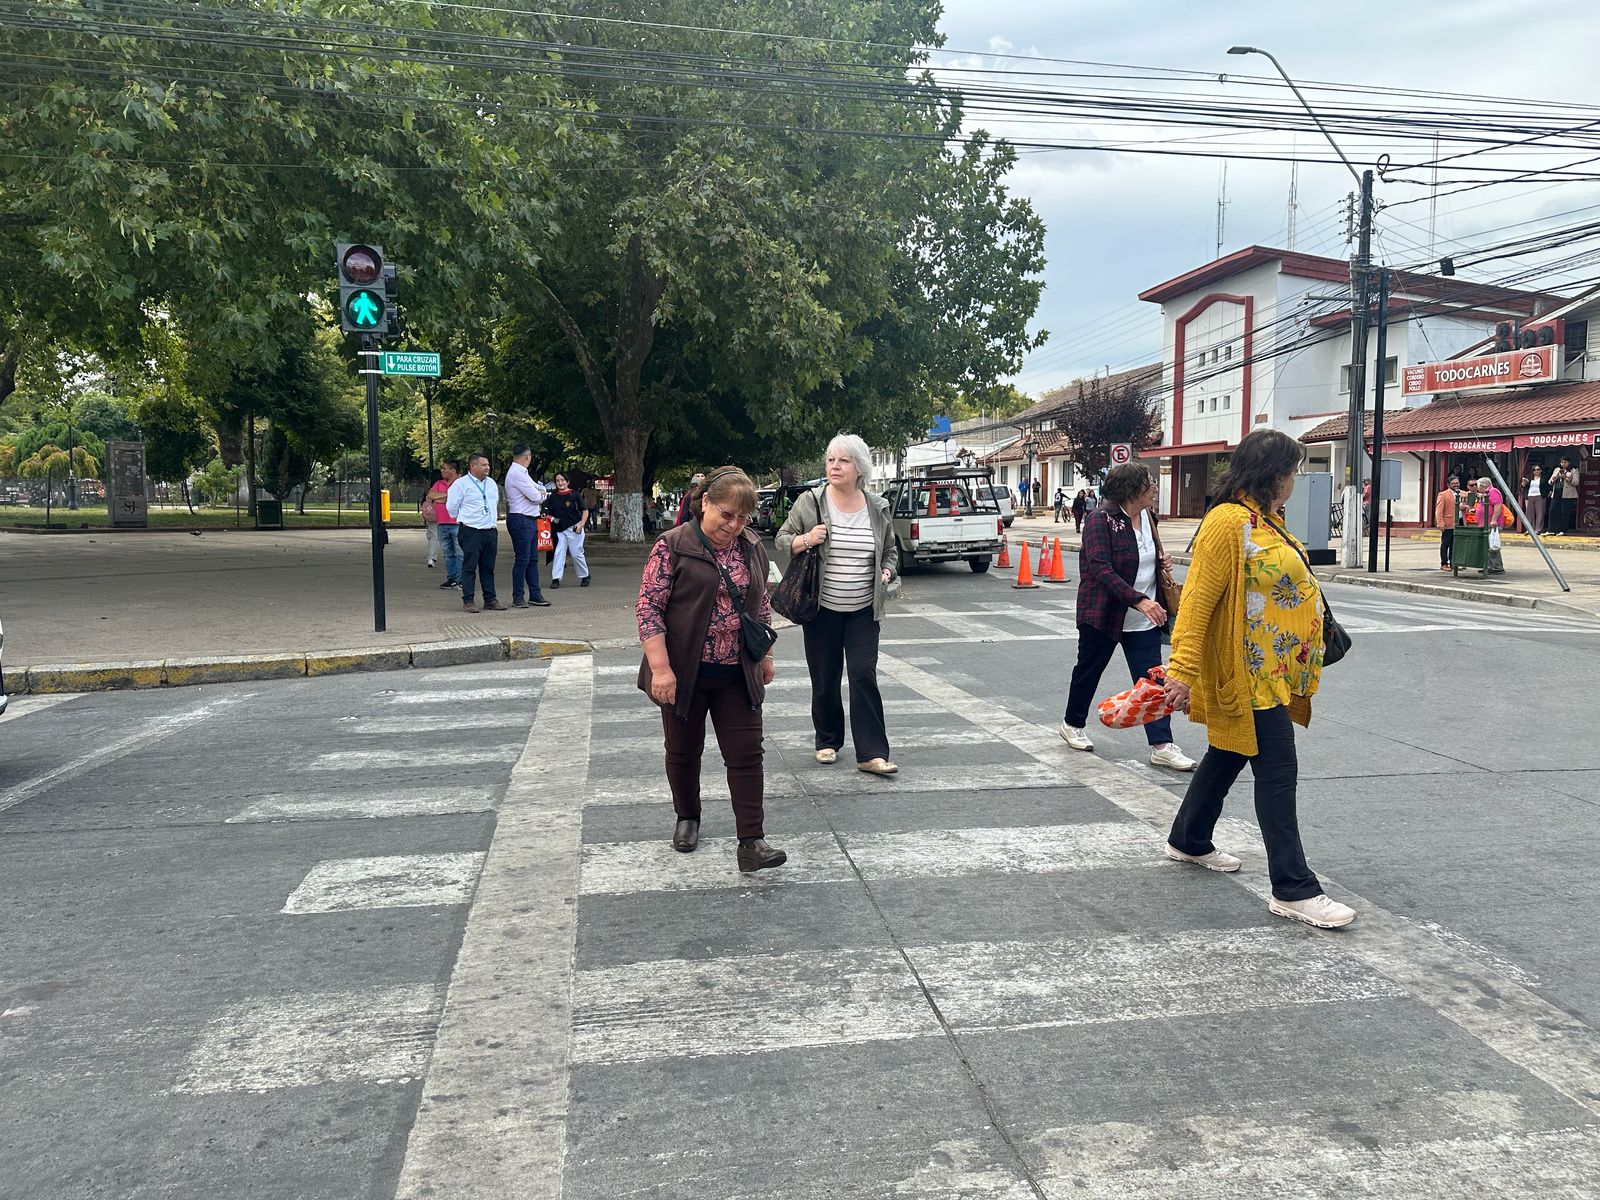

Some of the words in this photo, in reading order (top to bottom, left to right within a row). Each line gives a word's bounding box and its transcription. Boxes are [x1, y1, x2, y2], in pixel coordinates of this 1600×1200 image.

[396, 355, 412, 363] PARA
[412, 356, 437, 364] CRUZAR
[397, 363, 417, 371] PULSE
[417, 362, 437, 372] BOTÓN
[1434, 361, 1510, 383] TODOCARNES
[1529, 433, 1588, 444] TODOCARNES
[1449, 441, 1497, 450] TODOCARNES
